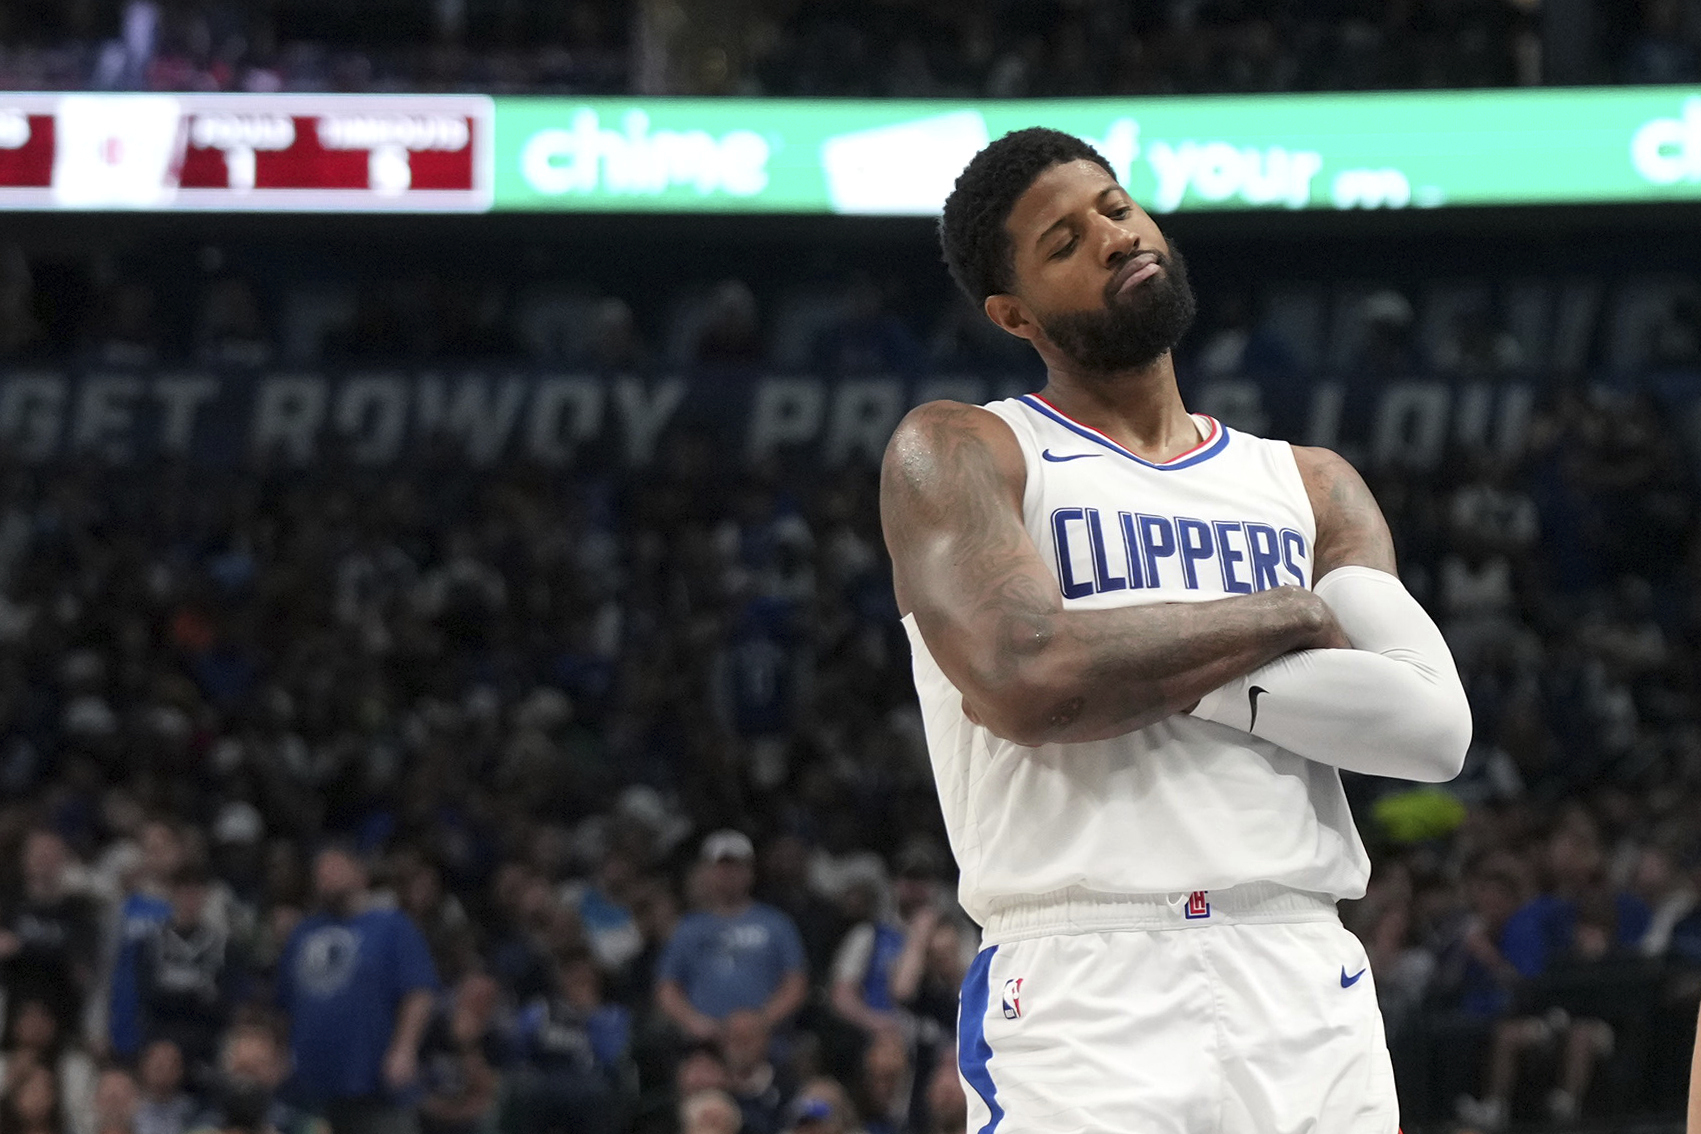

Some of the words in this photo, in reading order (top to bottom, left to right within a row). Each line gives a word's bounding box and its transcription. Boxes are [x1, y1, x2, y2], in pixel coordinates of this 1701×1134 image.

[522, 108, 772, 197] chime
[1146, 139, 1323, 212] your
[1, 371, 218, 464] GET
[254, 371, 686, 467] ROWDY
[1308, 380, 1537, 468] LOU
[1050, 507, 1306, 600] CLIPPERS
